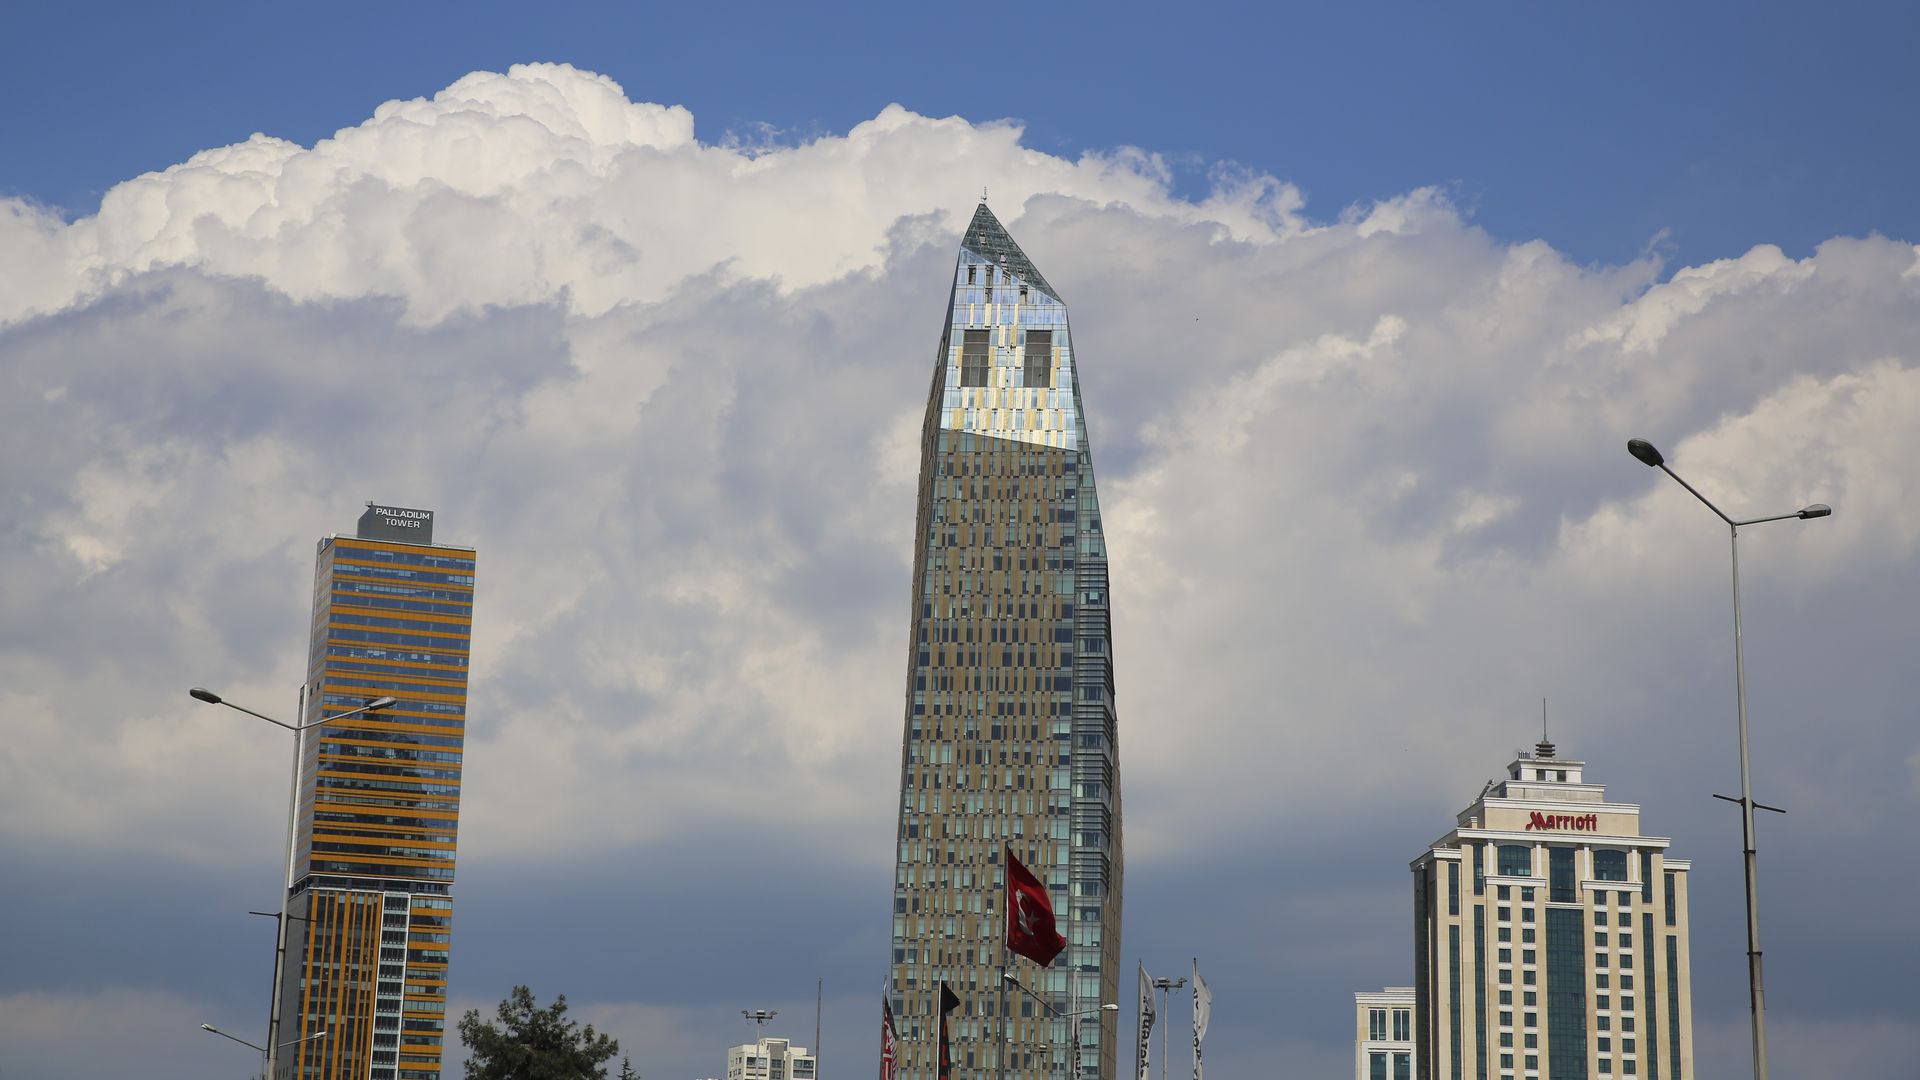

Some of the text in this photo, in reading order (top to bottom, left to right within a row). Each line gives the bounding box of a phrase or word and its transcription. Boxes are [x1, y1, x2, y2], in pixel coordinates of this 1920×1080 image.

[375, 508, 430, 520] PALLADIUM
[385, 518, 420, 528] TOWER
[1525, 811, 1597, 831] Marriott
